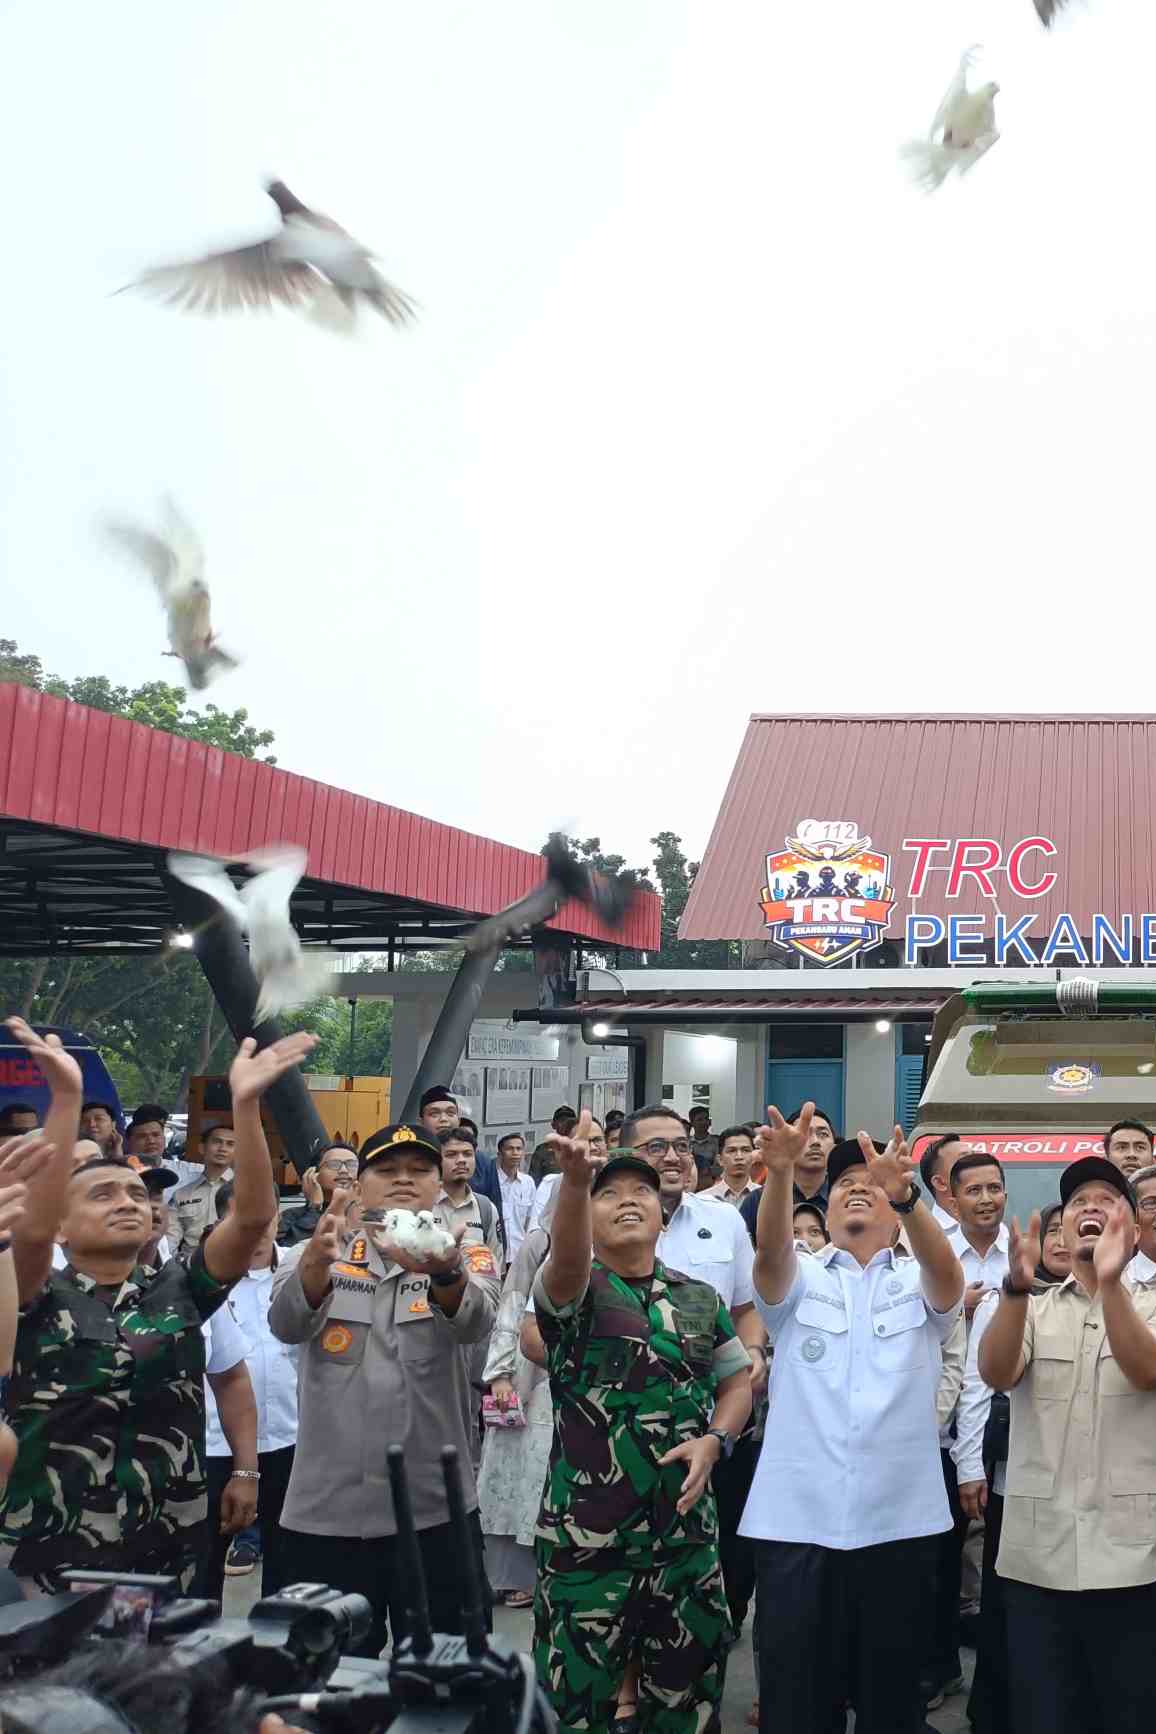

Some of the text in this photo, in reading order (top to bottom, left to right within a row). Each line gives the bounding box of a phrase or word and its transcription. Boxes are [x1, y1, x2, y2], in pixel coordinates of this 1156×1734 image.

[823, 823, 856, 839] 112
[901, 836, 1058, 898] TRC
[786, 898, 866, 924] TRC
